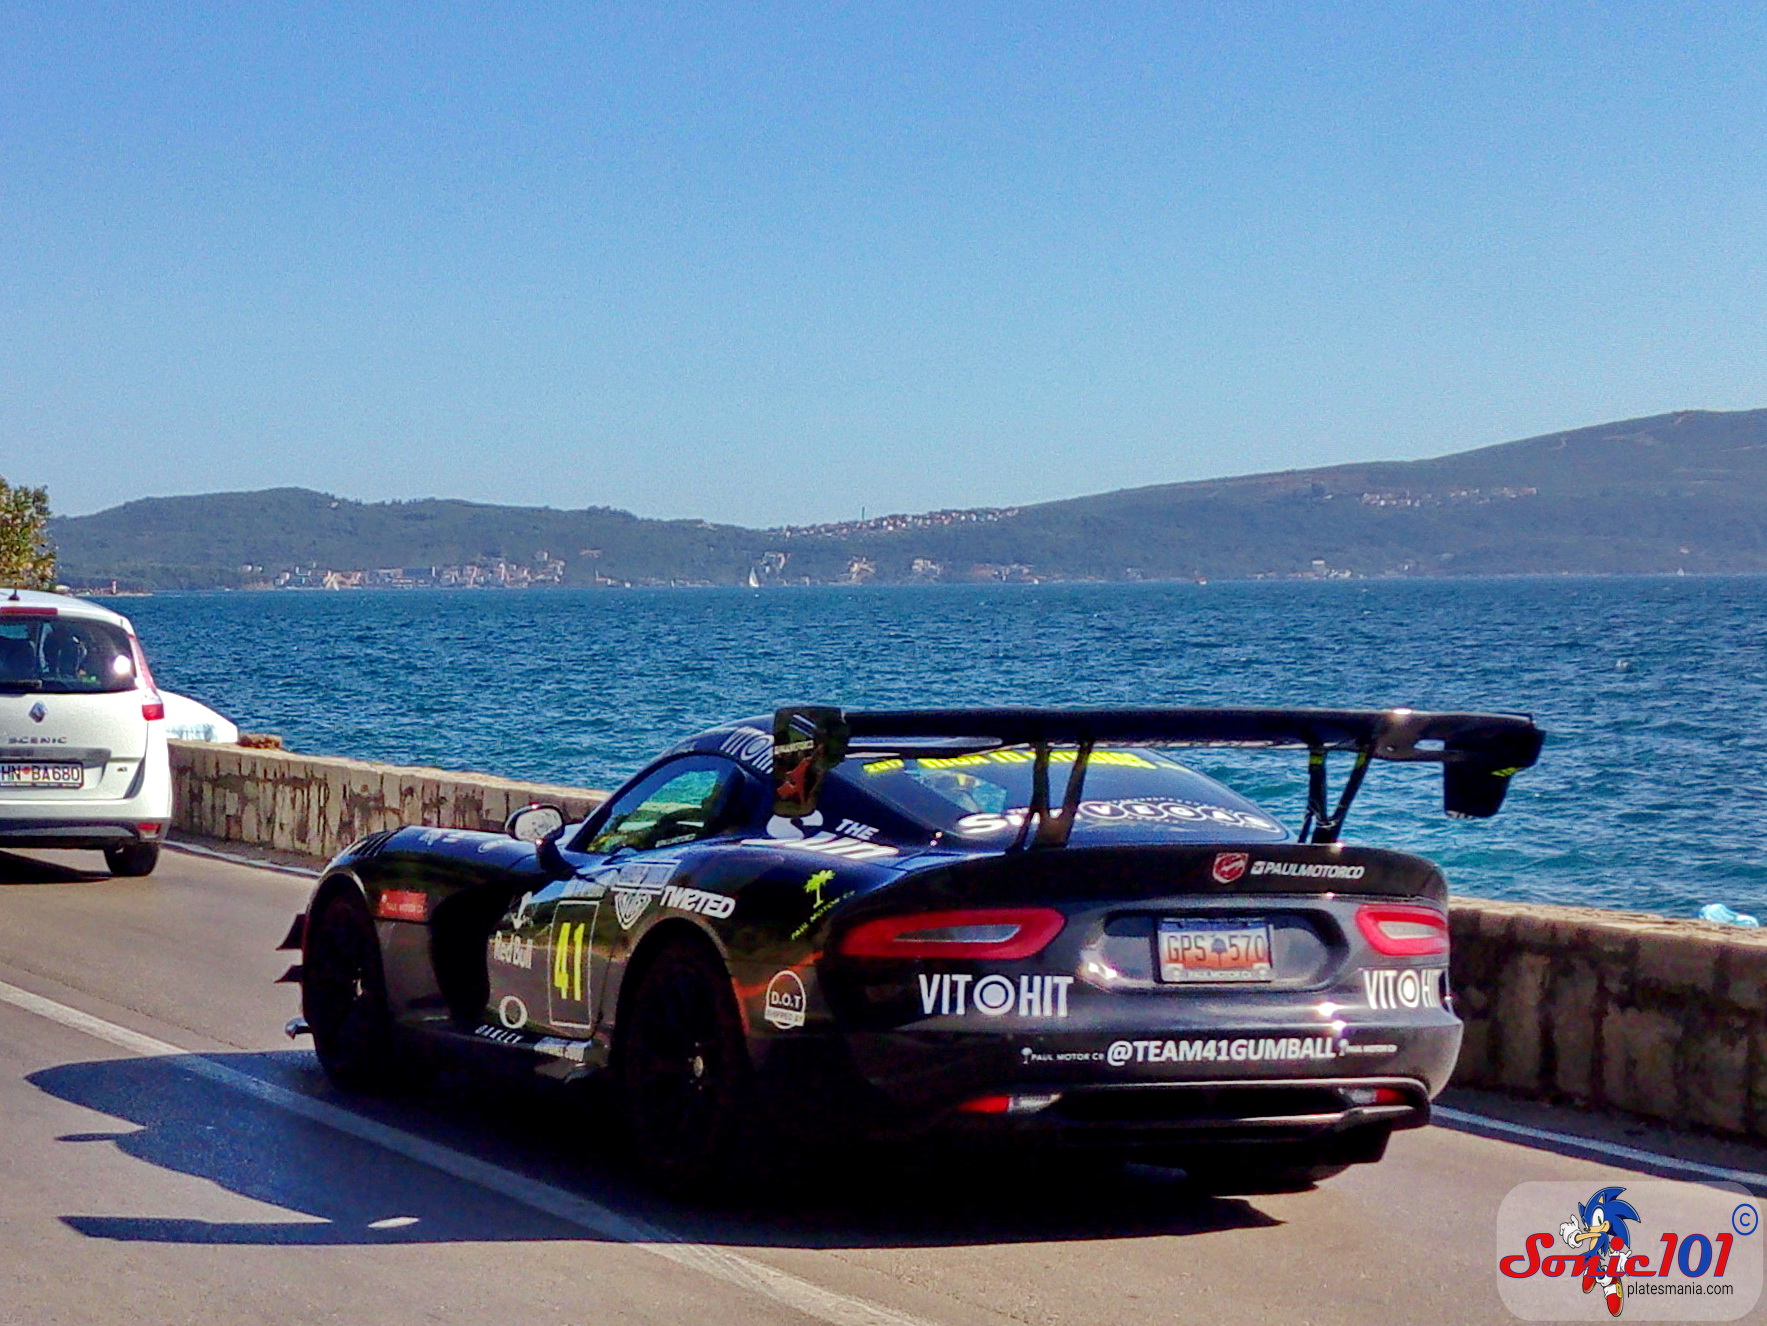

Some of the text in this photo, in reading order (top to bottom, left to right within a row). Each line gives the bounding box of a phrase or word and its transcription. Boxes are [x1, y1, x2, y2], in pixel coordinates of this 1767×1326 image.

[1, 765, 21, 781] HN
[835, 818, 879, 840] THE
[1167, 934, 1266, 963] GPS 570
[554, 922, 586, 1002] 41
[771, 991, 802, 1009] D.O.T
[1107, 1037, 1336, 1067] @TEAM41GUMBALL
